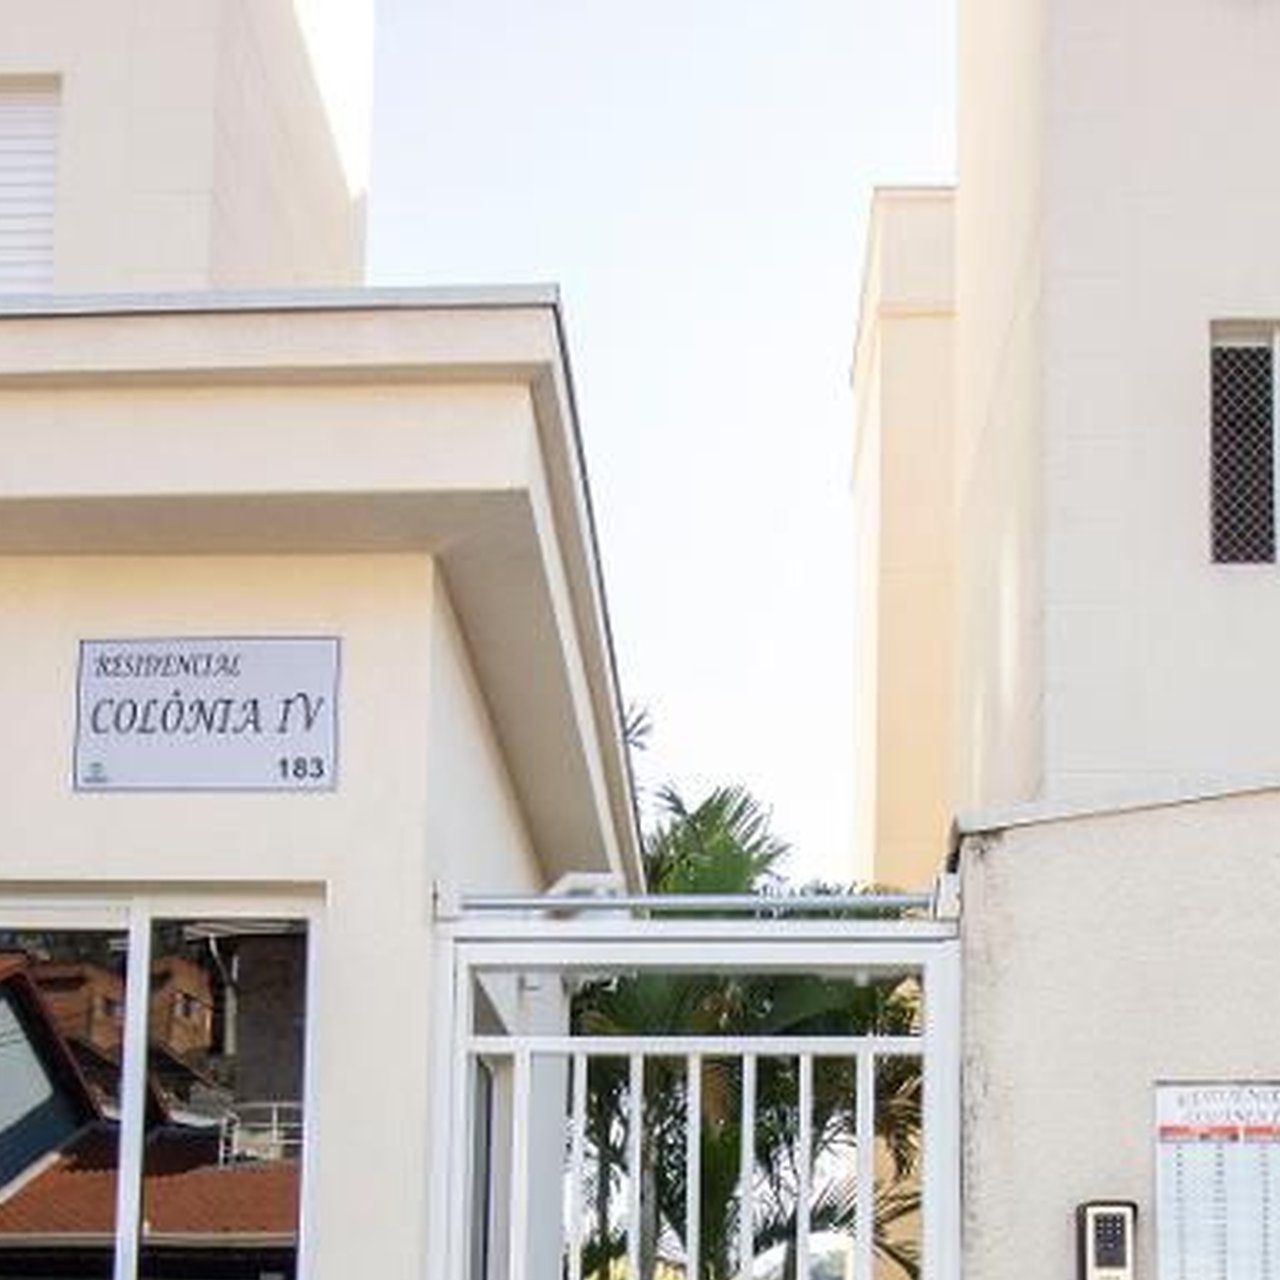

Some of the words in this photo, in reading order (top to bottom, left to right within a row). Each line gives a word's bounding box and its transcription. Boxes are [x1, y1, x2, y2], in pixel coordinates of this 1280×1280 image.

[95, 653, 241, 678] RESIDENCIAL
[91, 688, 262, 735] COLÔNIA
[276, 692, 325, 734] IV
[278, 757, 325, 779] 183
